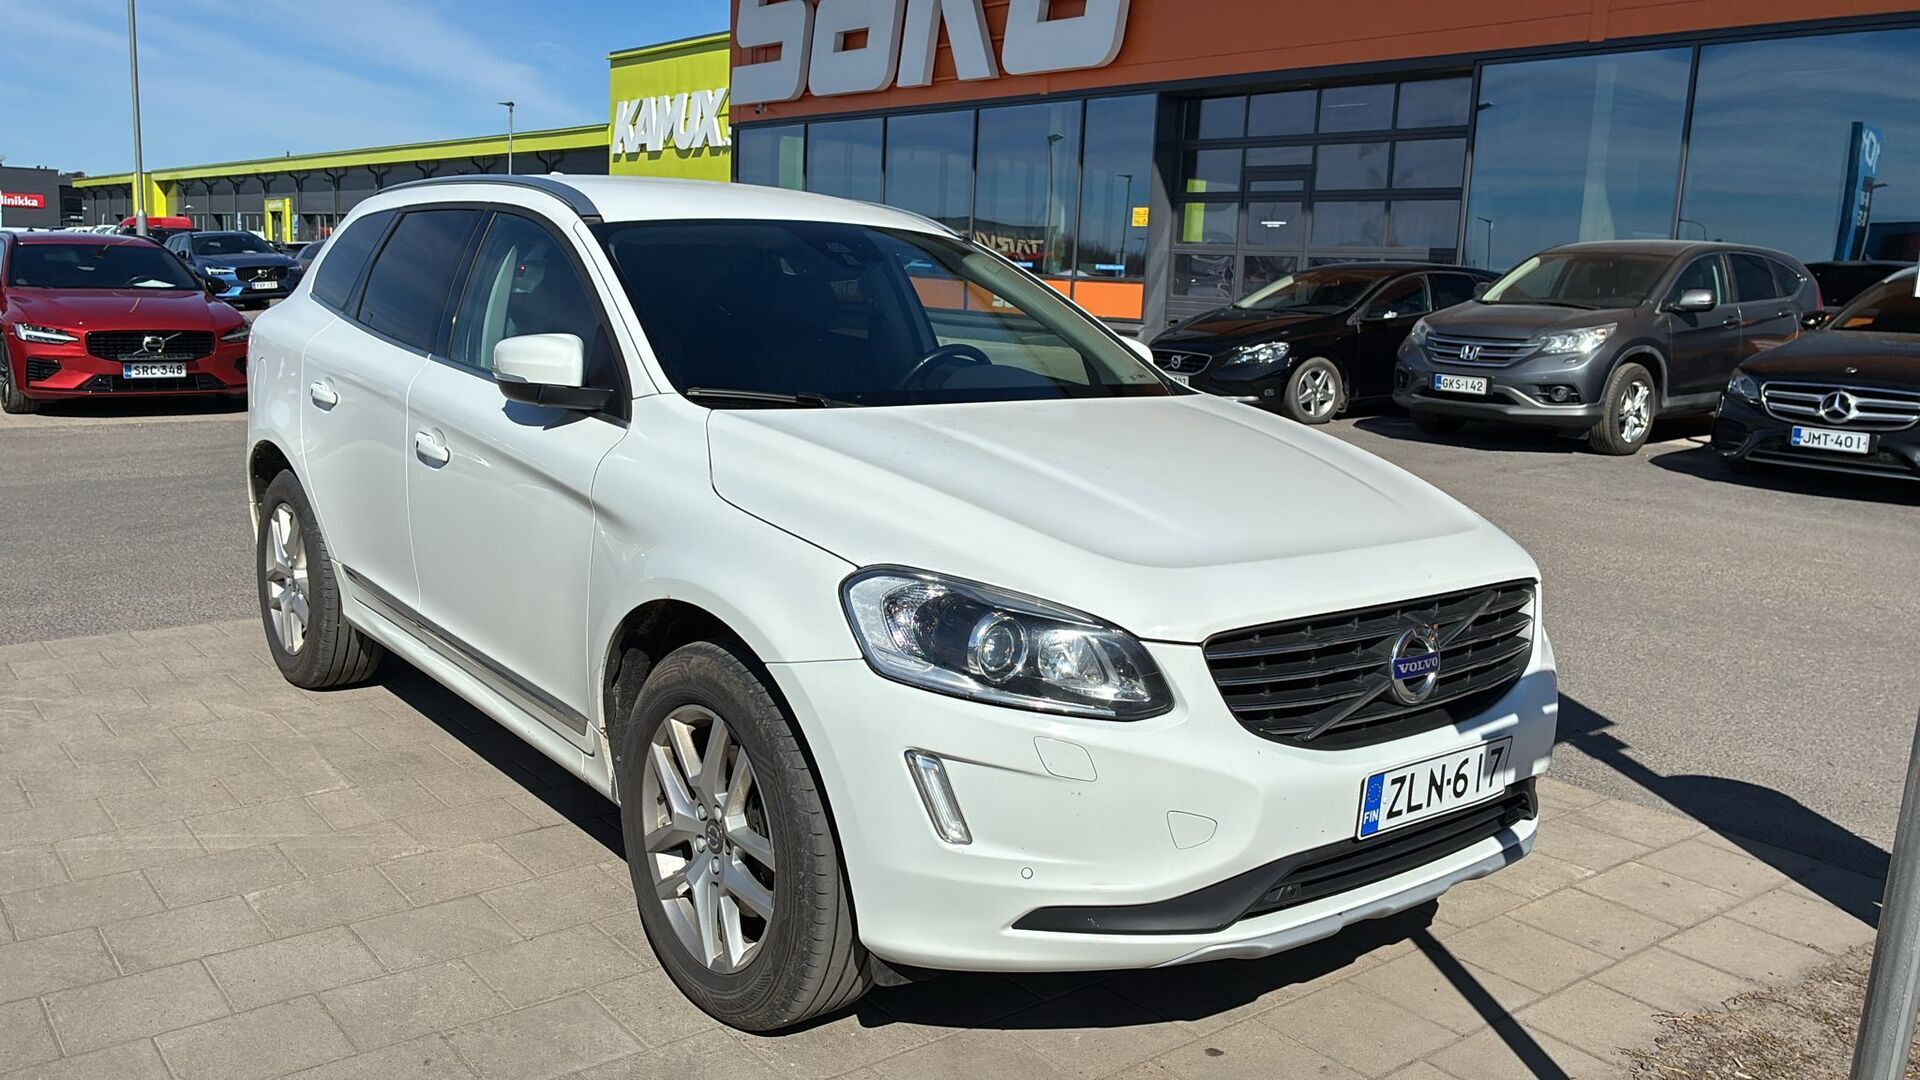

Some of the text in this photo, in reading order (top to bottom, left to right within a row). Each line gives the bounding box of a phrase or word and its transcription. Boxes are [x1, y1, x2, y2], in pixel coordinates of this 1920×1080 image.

[134, 364, 183, 376] SRC-348
[1442, 377, 1483, 392] GKS-142
[1803, 431, 1862, 450] JMT-401
[1397, 656, 1438, 674] VOLVO
[1386, 746, 1505, 821] ZLN-617
[1363, 808, 1380, 825] FIN
